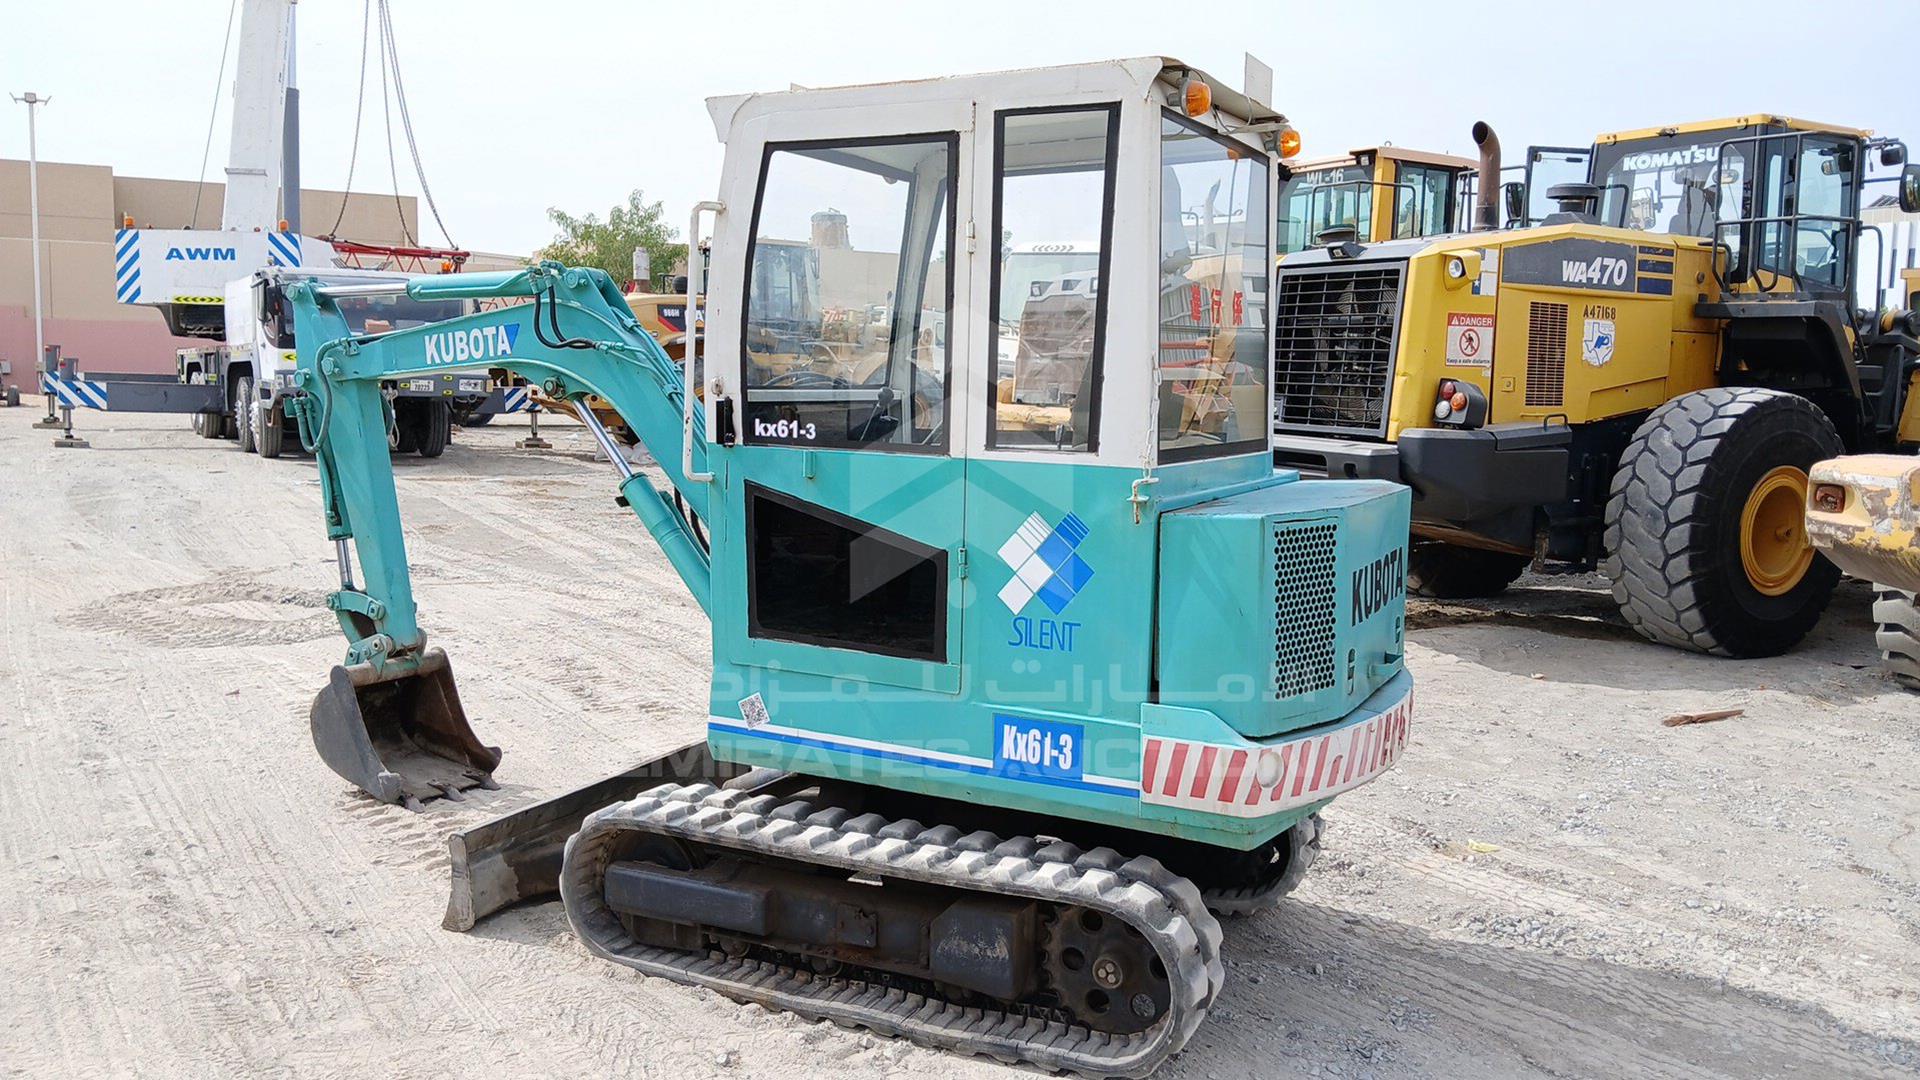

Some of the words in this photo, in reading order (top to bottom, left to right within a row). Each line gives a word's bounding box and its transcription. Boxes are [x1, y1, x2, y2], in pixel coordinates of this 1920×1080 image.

[1623, 144, 1720, 171] KOMATSU
[165, 247, 236, 260] AWM
[1562, 257, 1628, 286] WA470
[1460, 316, 1493, 326] DANGER
[1583, 304, 1617, 320] A47168
[424, 325, 512, 365] KUBOTA
[755, 418, 816, 440] kx61-3
[1352, 546, 1403, 628] KUBOTA
[1008, 616, 1081, 652] SILENT
[1003, 724, 1073, 770] Kx61-3
